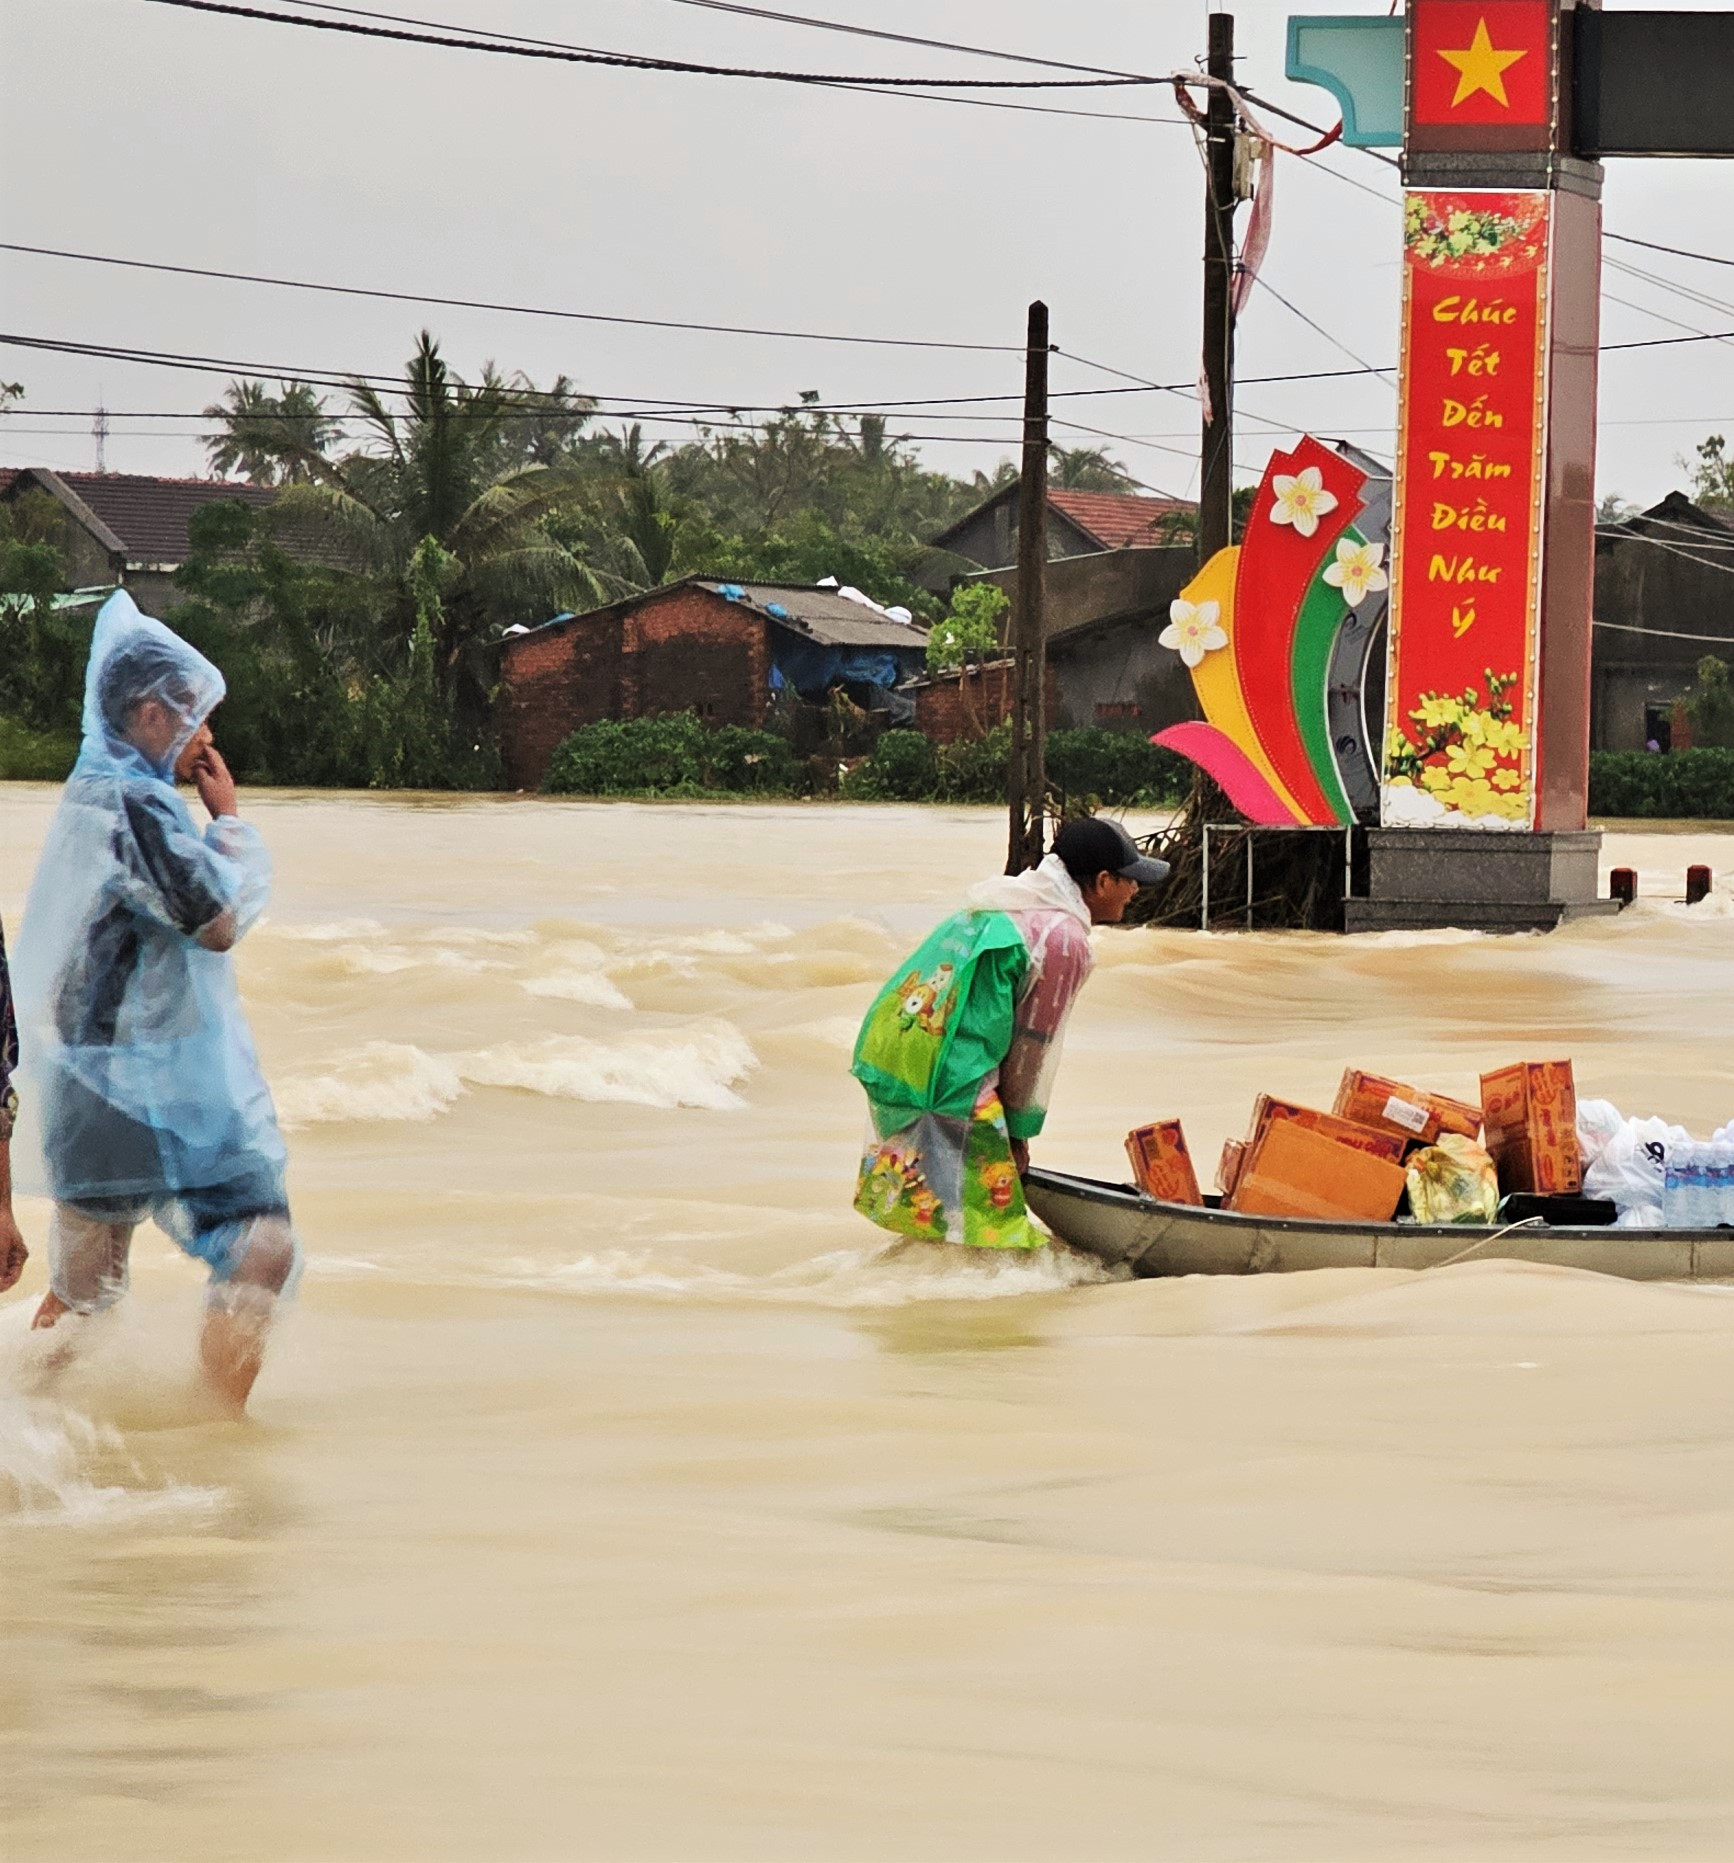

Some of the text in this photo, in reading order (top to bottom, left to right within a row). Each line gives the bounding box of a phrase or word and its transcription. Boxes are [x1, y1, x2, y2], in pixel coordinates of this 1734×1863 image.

[1432, 295, 1517, 325] Chúc
[1446, 343, 1500, 376] Tết
[1442, 394, 1503, 428] Đến
[1428, 451, 1511, 480] Trăm
[1431, 497, 1506, 532] Điều
[1428, 554, 1502, 584] Như
[1451, 597, 1476, 639] Ý
